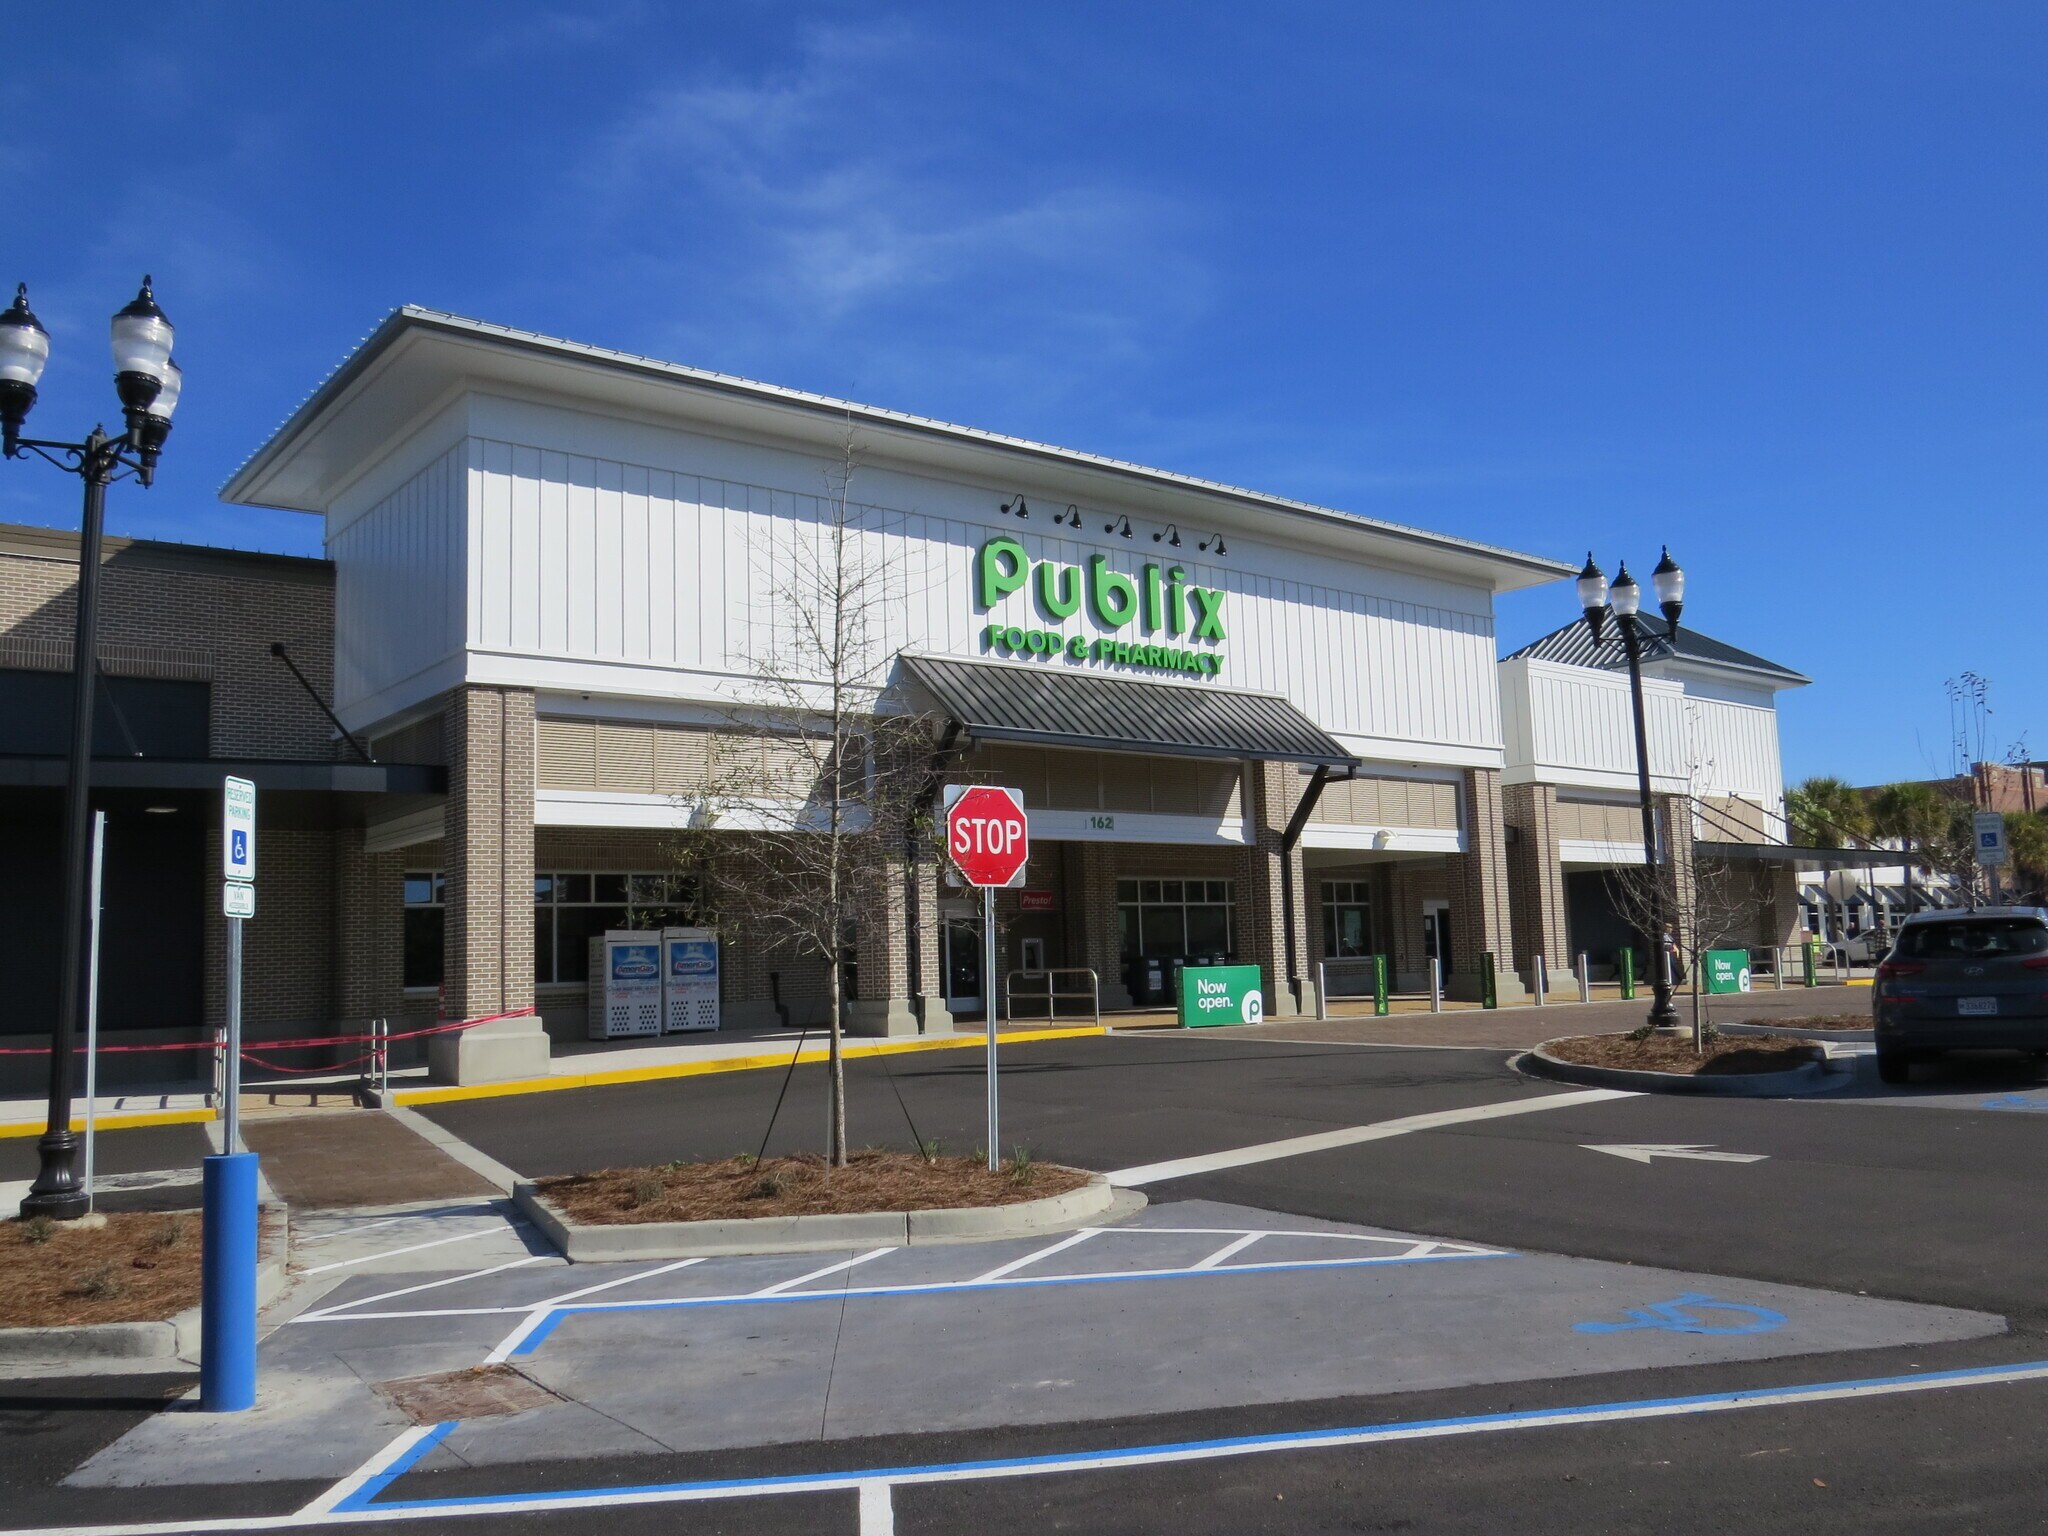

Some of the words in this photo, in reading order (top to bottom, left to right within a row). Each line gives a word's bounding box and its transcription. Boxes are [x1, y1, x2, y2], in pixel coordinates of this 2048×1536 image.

[980, 536, 1226, 640] Publix
[988, 624, 1064, 654] FOOD
[1071, 635, 1090, 658] &
[1096, 638, 1225, 674] PHARMACY
[227, 787, 252, 804] RESERVED
[228, 804, 251, 820] PARKING
[1090, 816, 1113, 829] 162
[955, 817, 1022, 854] STOP
[234, 891, 244, 900] VAN
[1023, 895, 1052, 905] Presto!
[1714, 959, 1731, 970] Now
[1715, 972, 1735, 983] open.
[1197, 979, 1227, 994] Now
[1198, 996, 1233, 1013] open.
